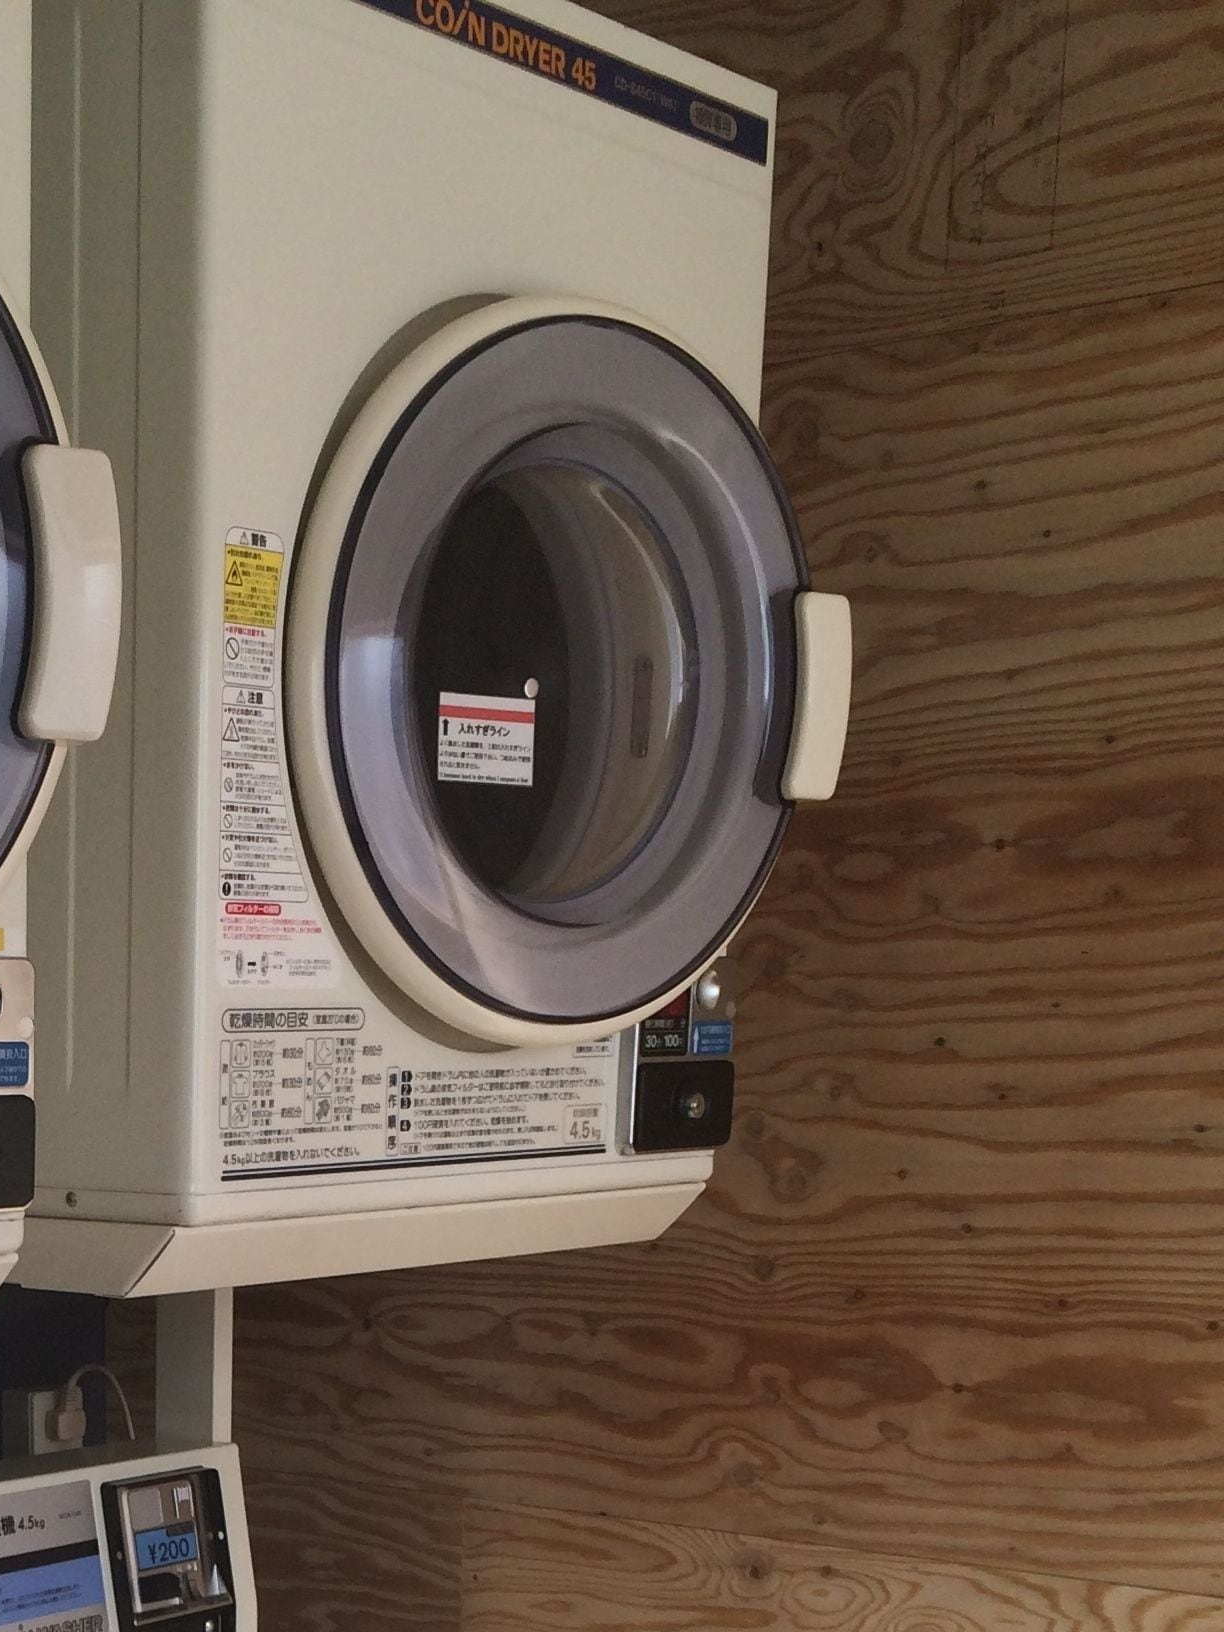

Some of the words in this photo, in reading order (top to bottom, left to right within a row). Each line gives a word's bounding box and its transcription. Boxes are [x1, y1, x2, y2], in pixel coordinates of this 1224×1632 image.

[415, 0, 486, 46] COIN
[491, 23, 566, 79] DRYER
[571, 58, 596, 92] 45
[229, 1012, 309, 1029] 乾燥時間の目安
[17, 1515, 46, 1532] 4.5kg
[148, 1538, 189, 1564] ¥200
